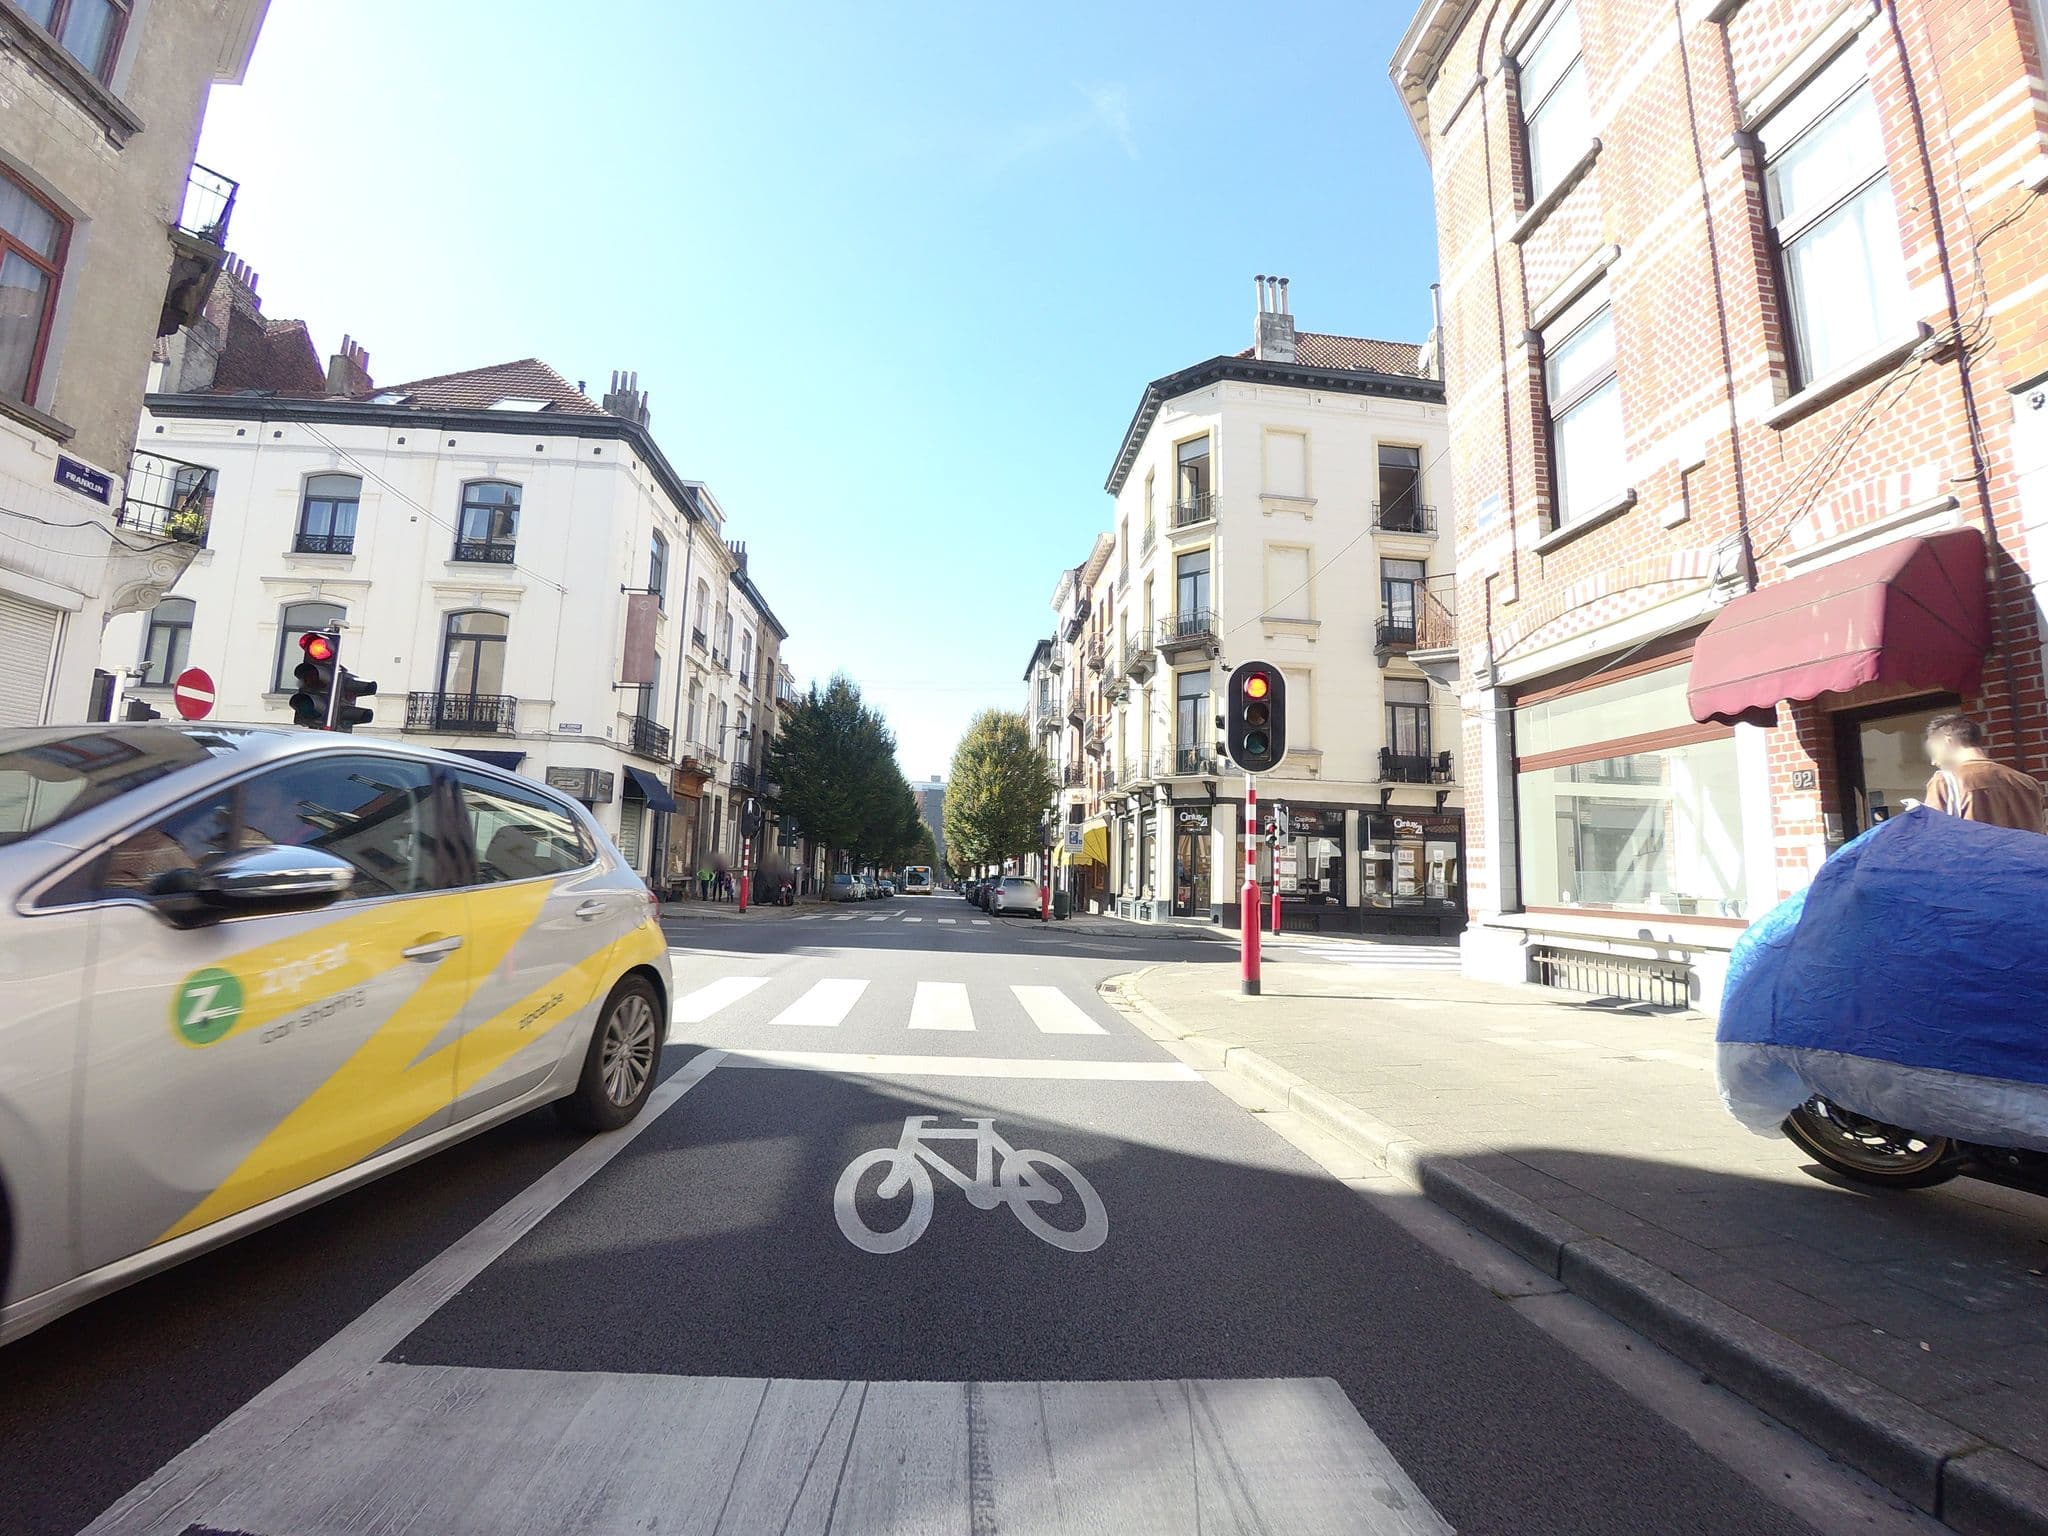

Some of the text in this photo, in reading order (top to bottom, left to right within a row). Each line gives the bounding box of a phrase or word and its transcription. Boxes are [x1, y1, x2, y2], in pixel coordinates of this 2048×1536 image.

[65, 471, 104, 494] FRANKLIN
[1793, 770, 1813, 788] 92
[259, 1021, 294, 1045] car
